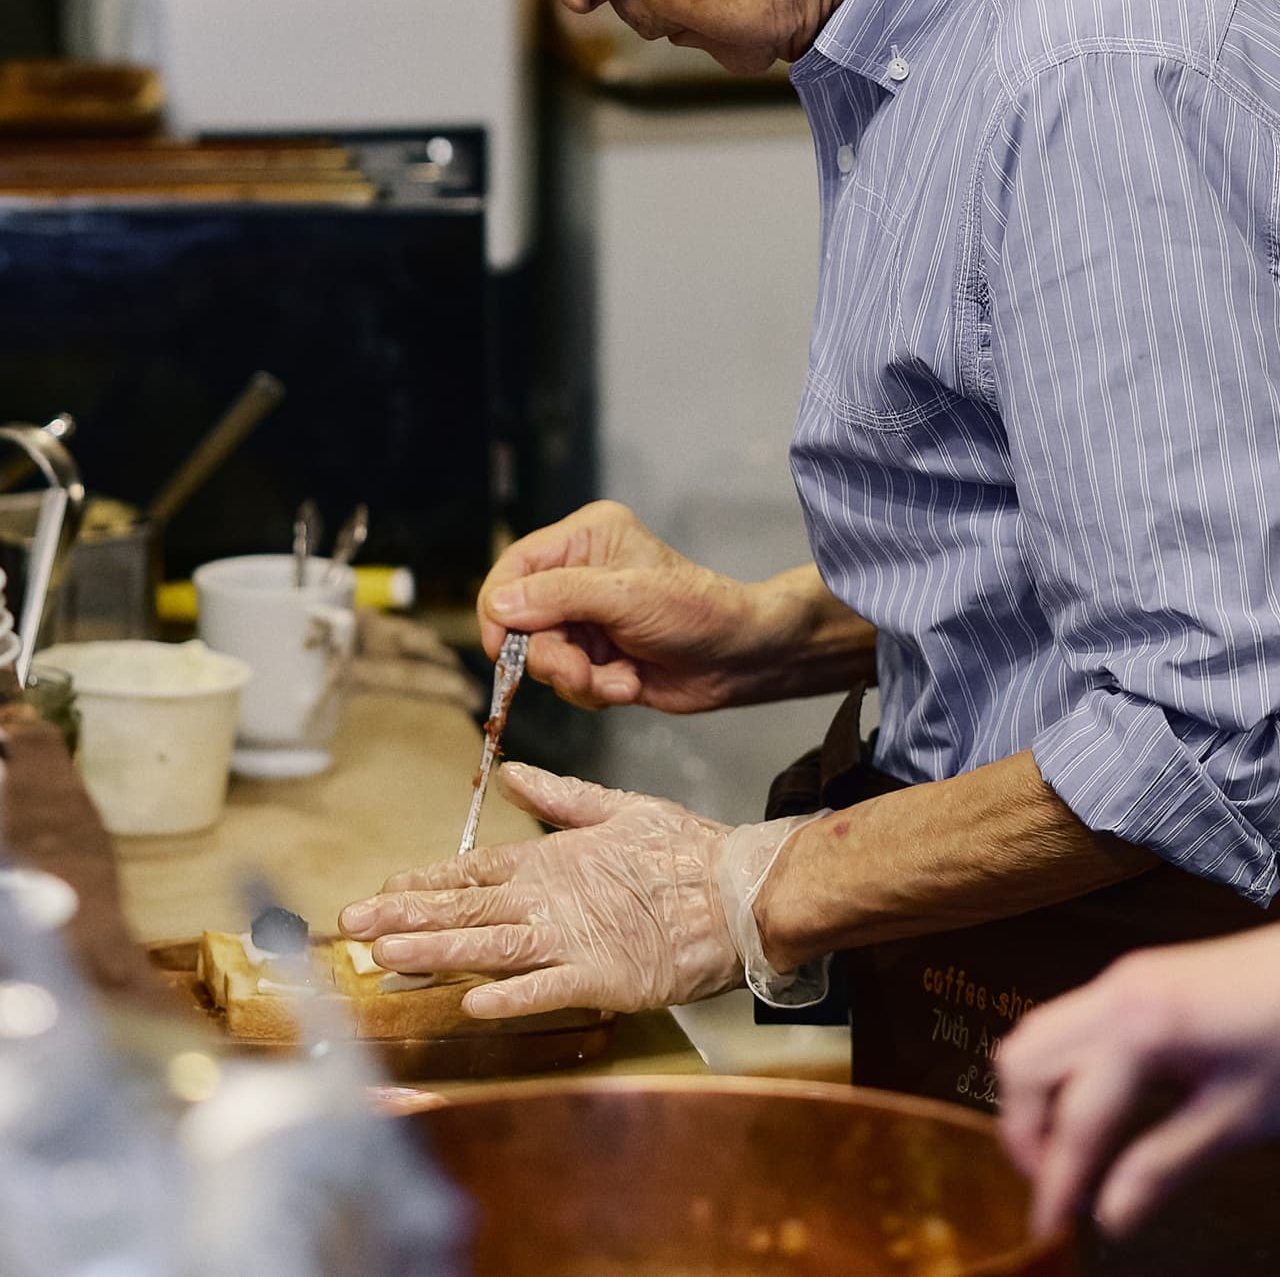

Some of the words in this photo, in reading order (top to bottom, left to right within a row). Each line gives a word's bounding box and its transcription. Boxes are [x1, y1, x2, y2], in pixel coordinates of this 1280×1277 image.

[923, 966, 987, 1011] coffee
[992, 985, 1038, 1022] sho
[932, 1008, 969, 1050] 70th
